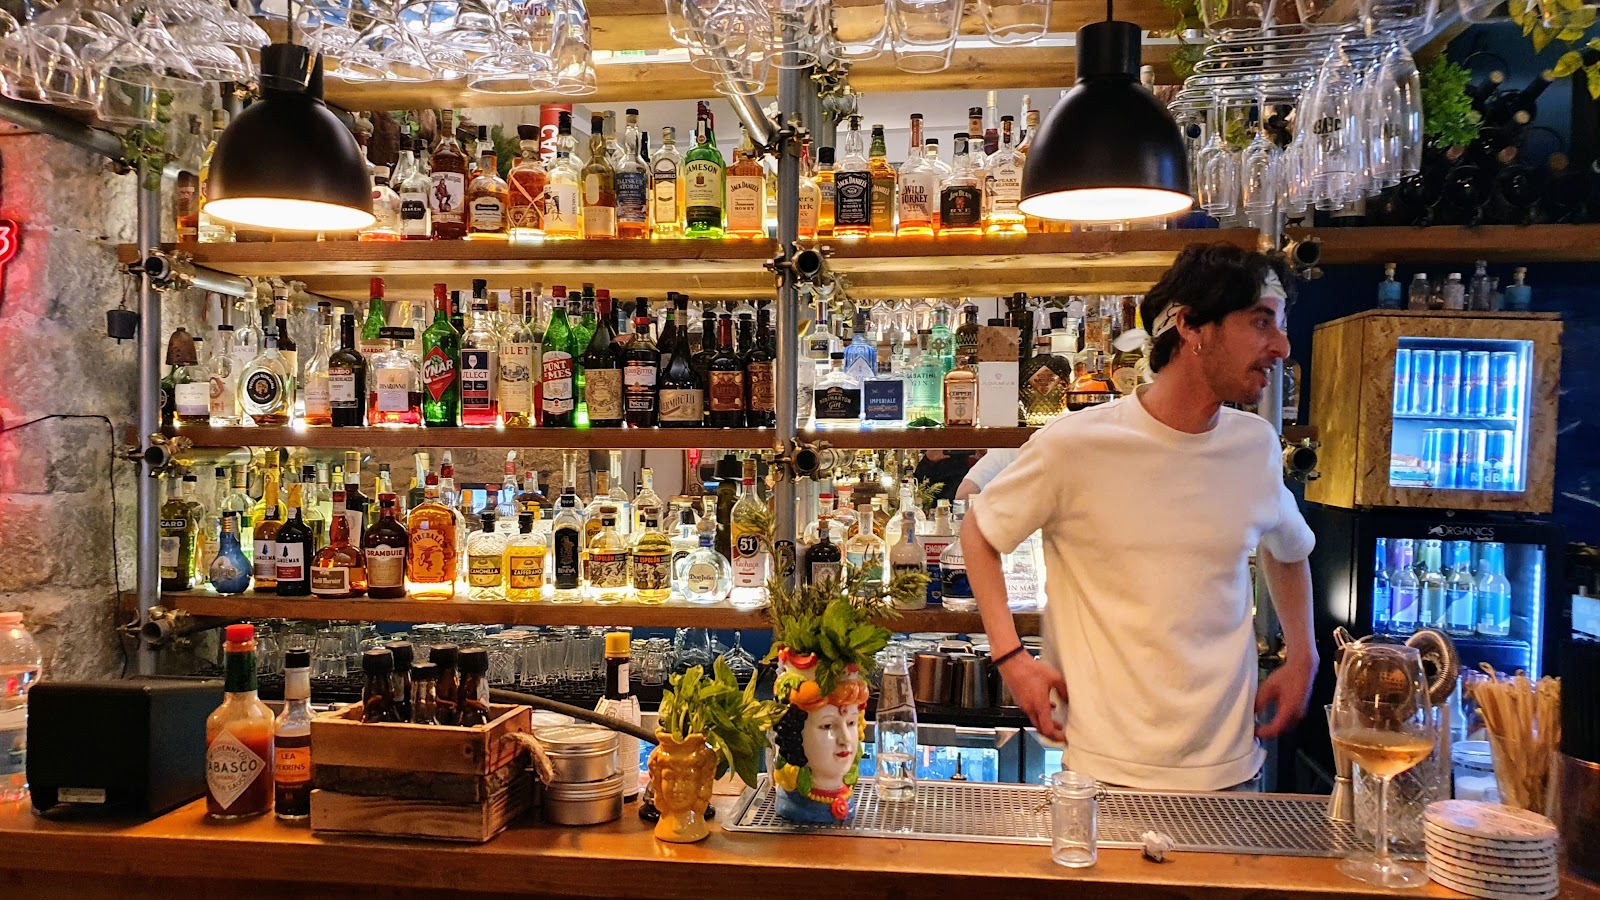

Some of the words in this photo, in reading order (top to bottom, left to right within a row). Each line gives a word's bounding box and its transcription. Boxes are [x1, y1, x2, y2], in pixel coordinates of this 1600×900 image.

[686, 164, 718, 175] JAMESON
[904, 185, 924, 194] WILD
[902, 194, 928, 205] TURKEY
[501, 347, 530, 355] ILLET
[543, 361, 566, 371] PUNT
[423, 359, 454, 384] CYNAR
[548, 369, 572, 379] MES
[412, 532, 444, 545] FIREBALL
[740, 537, 754, 550] 51
[367, 549, 403, 557] DRAMBUIE
[281, 752, 296, 760] LEA
[208, 759, 258, 773] ABASCO
